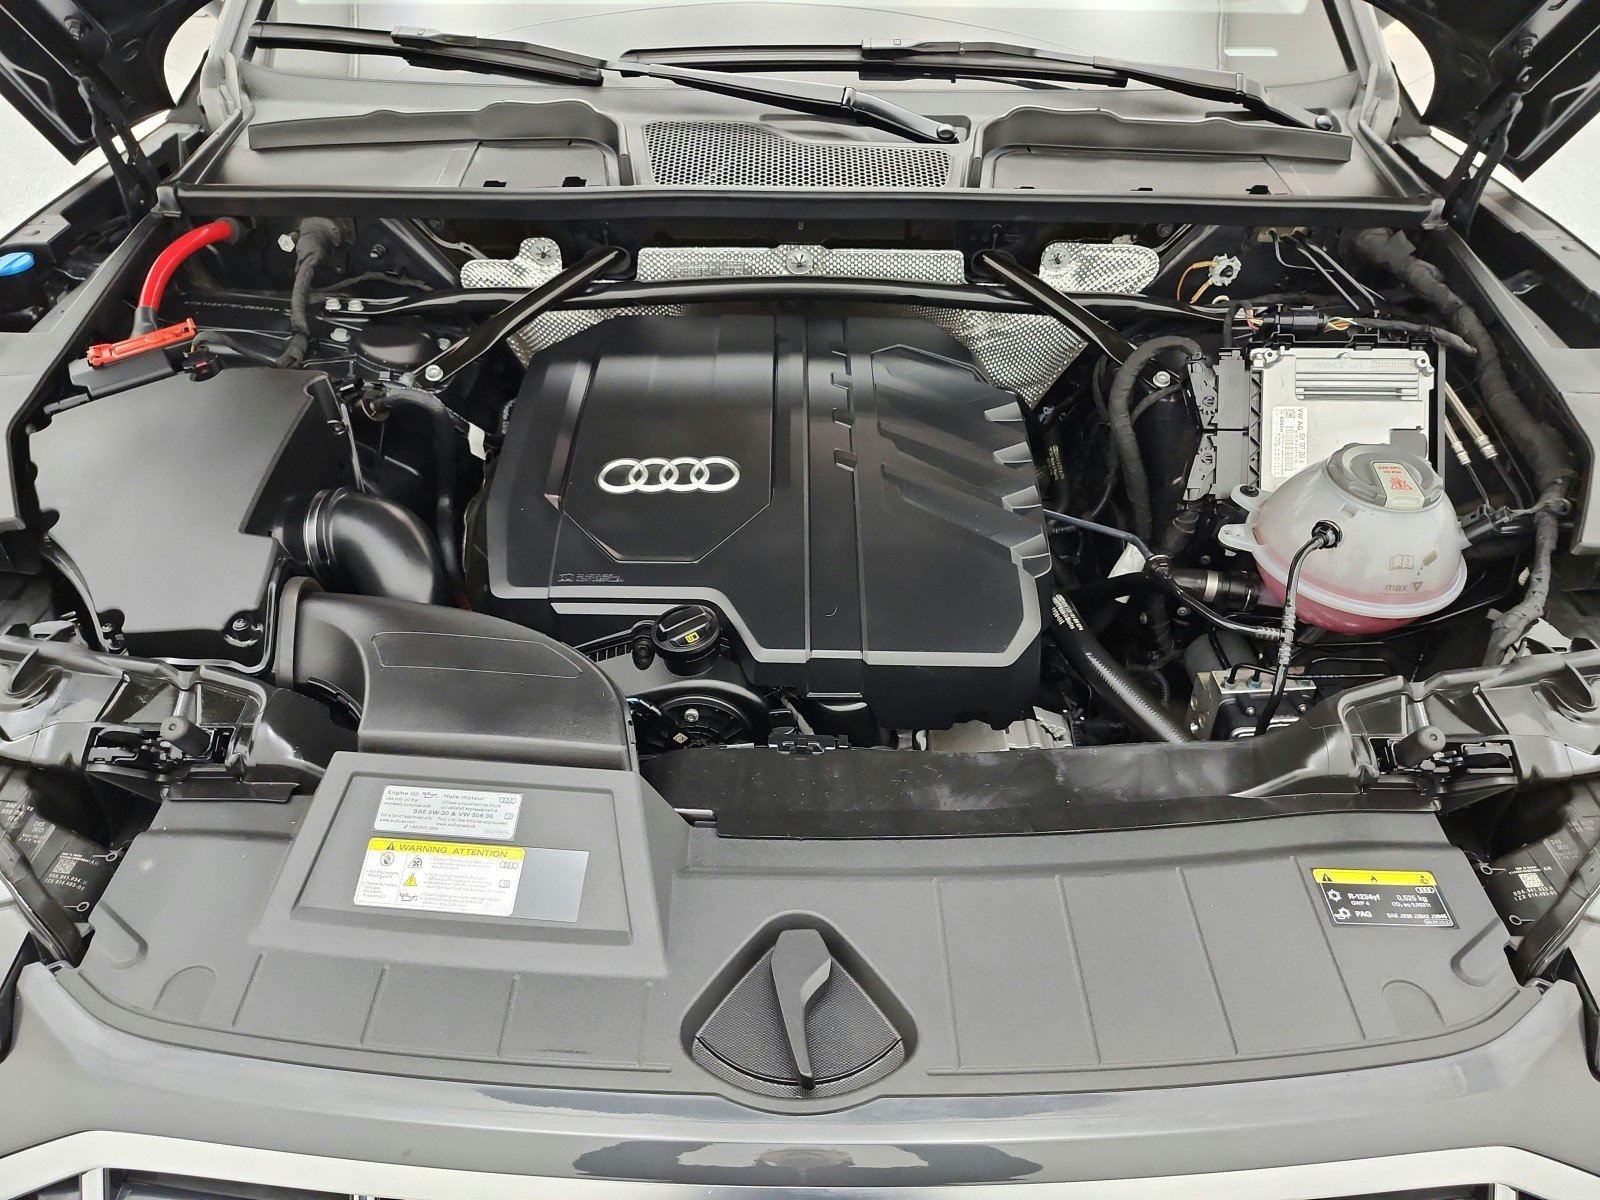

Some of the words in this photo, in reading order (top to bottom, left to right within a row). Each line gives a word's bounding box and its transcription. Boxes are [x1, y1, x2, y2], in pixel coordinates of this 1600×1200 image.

[399, 844, 448, 854] WARNING
[452, 848, 508, 858] ATTENTION
[1347, 893, 1381, 901] R-1234yf
